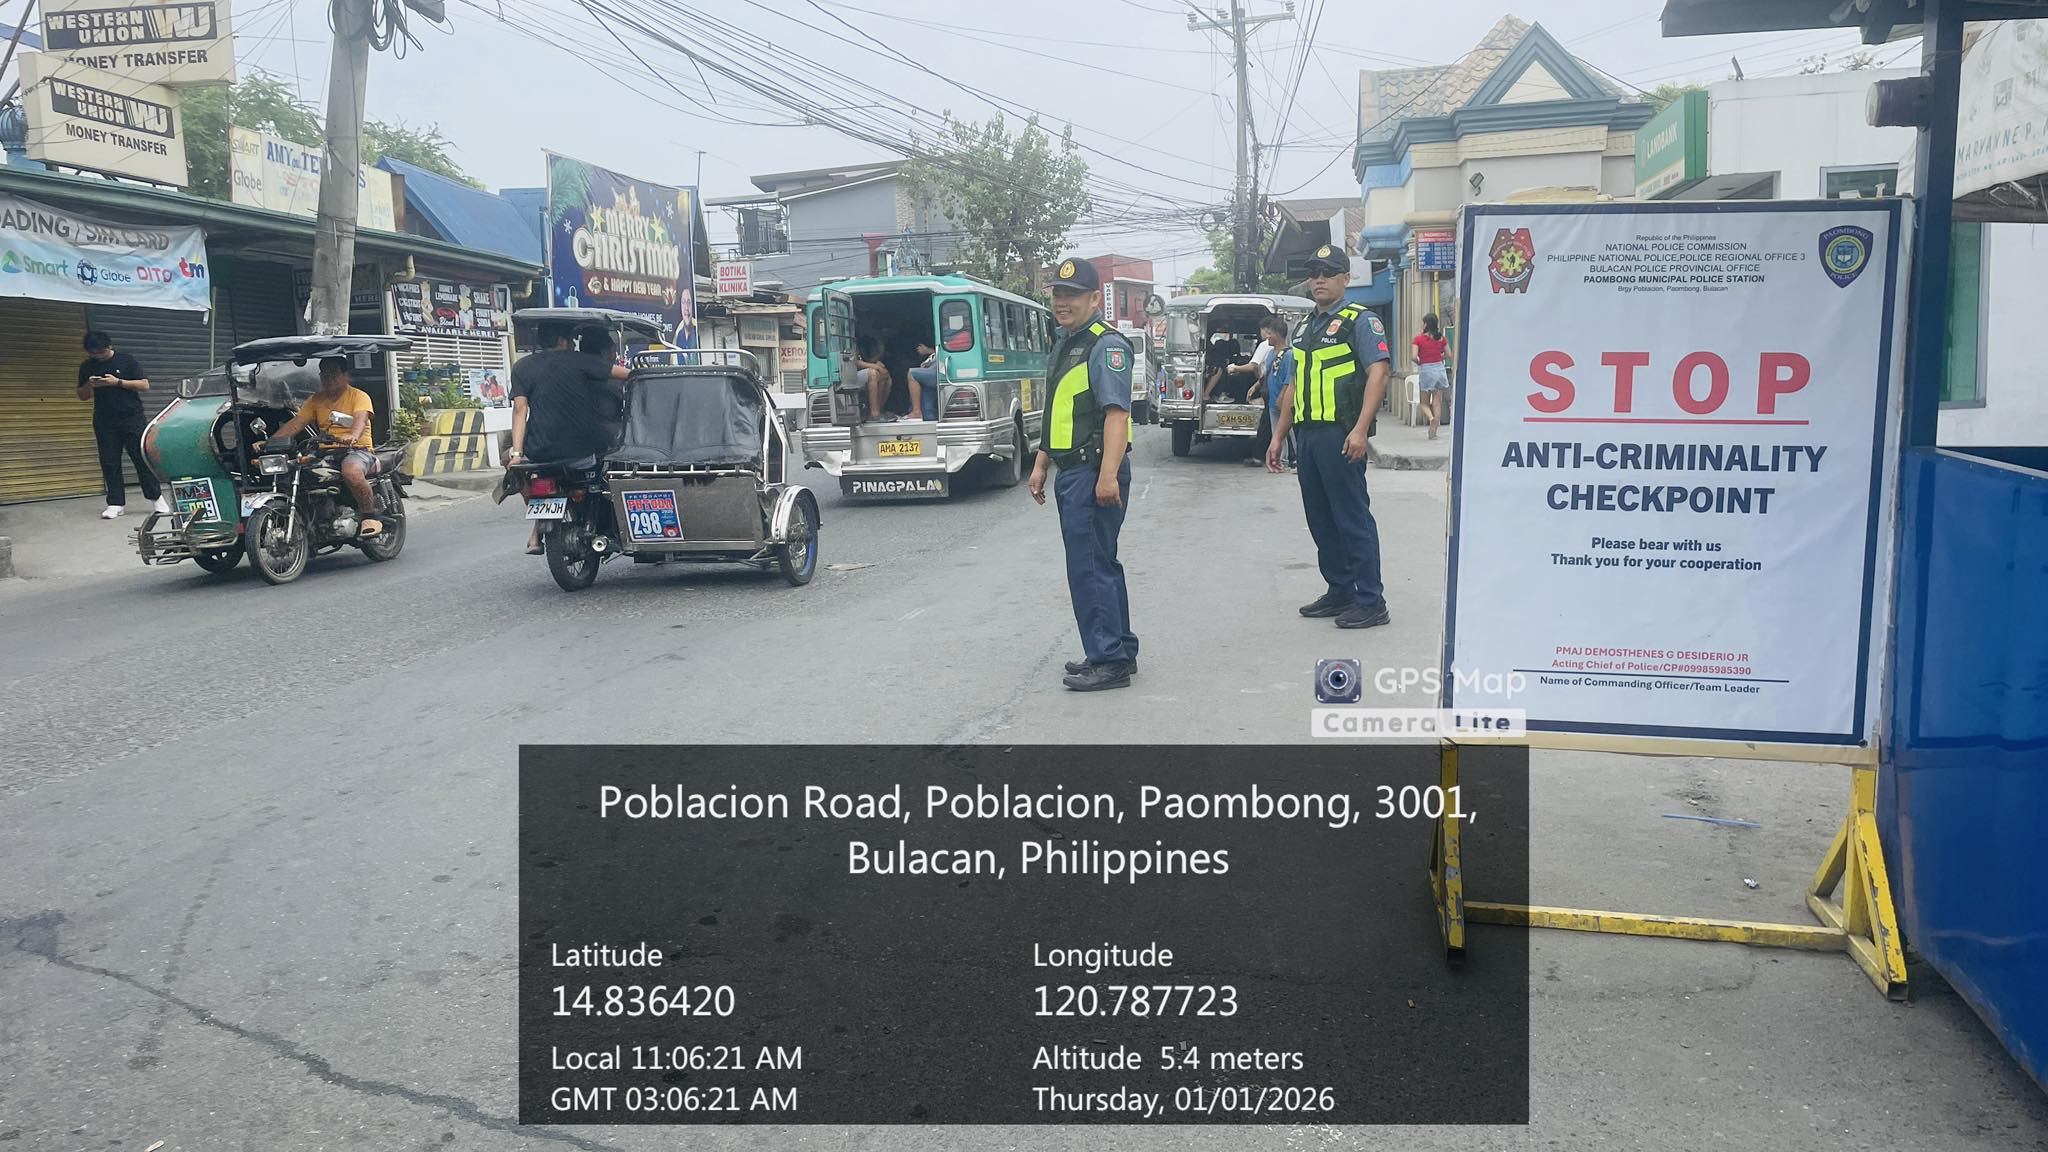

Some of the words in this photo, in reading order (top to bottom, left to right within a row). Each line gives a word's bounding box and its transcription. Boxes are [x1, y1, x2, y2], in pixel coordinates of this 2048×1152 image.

[47, 10, 144, 30] WESTERN
[78, 26, 145, 44] UNION
[124, 50, 208, 67] TRANSFER
[54, 82, 124, 111] WESTERN
[77, 101, 125, 124] UNION
[66, 123, 107, 143] MONEY
[110, 133, 167, 156] TRANSFER
[266, 141, 293, 166] AMY
[233, 170, 263, 191] Globe
[0, 208, 70, 238] ADING
[122, 231, 170, 251] CARD
[605, 208, 650, 240] MERRY
[1605, 243, 1649, 251] NATIONAL
[1651, 243, 1684, 251] POLICE
[1687, 242, 1746, 251] COMMISSION
[1636, 234, 1662, 242] Republic
[1683, 234, 1716, 242] Philippines
[573, 227, 680, 280] CHRISTMAS
[1547, 254, 1596, 262] PHILIPPINE
[1598, 254, 1640, 262] NATIONAL
[1715, 253, 1762, 261] REGIONAL
[1764, 252, 1797, 261] OFFICE
[1800, 252, 1806, 260] 3
[23, 255, 69, 276] Smart
[101, 268, 131, 282] Globe
[137, 266, 173, 283] DITO
[720, 266, 747, 277] BOTIKA
[1590, 264, 1632, 273] BULACAN
[1634, 264, 1667, 272] POLICE
[1669, 264, 1724, 272] PROVINCIAL
[1726, 264, 1760, 272] OFFICE
[603, 278, 609, 291] &
[611, 278, 633, 293] HAPPY
[633, 280, 647, 295] NEW
[647, 282, 662, 297] YEAR
[719, 283, 748, 292] KLINIKA
[1584, 275, 1636, 283] PAOMBONG
[1638, 275, 1687, 283] MUNICIPAL
[1690, 275, 1724, 283] POLICE
[1726, 275, 1765, 283] STATION
[1618, 285, 1632, 293] Brgy
[421, 326, 468, 336] AVAILABLE
[1321, 336, 1337, 344] POLICE
[1526, 350, 1811, 415] STOP
[880, 443, 897, 453] AMA
[899, 442, 919, 452] 2137
[1501, 441, 1828, 472] ANTI-CRIMINALITY
[852, 480, 934, 493] PINAGPALA
[528, 503, 563, 514] 737WJH
[1547, 484, 1775, 515] CHECKPOINT
[630, 512, 662, 535] 298
[1591, 537, 1636, 550] Please
[1639, 538, 1669, 551] bear
[1673, 539, 1702, 552] with
[1706, 543, 1722, 552] us
[1551, 553, 1592, 566] Thank
[1595, 556, 1619, 569] you
[1623, 555, 1643, 568] for
[1645, 559, 1677, 570] your
[1679, 558, 1762, 572] cooperation
[1556, 646, 1582, 656] PMAJ
[1585, 647, 1664, 659] DEMOSTHENES
[1666, 650, 1674, 659] G
[1677, 650, 1735, 662] DESIDERIO
[1737, 653, 1749, 662] JR
[1551, 659, 1584, 670] Acting
[1586, 660, 1613, 669] Chief
[1615, 661, 1626, 670] of
[1540, 676, 1570, 686] Name
[1572, 677, 1582, 686] of
[1584, 677, 1652, 690] Commanding
[1654, 680, 1722, 692] Officer/Team
[1724, 683, 1760, 694] Leader
